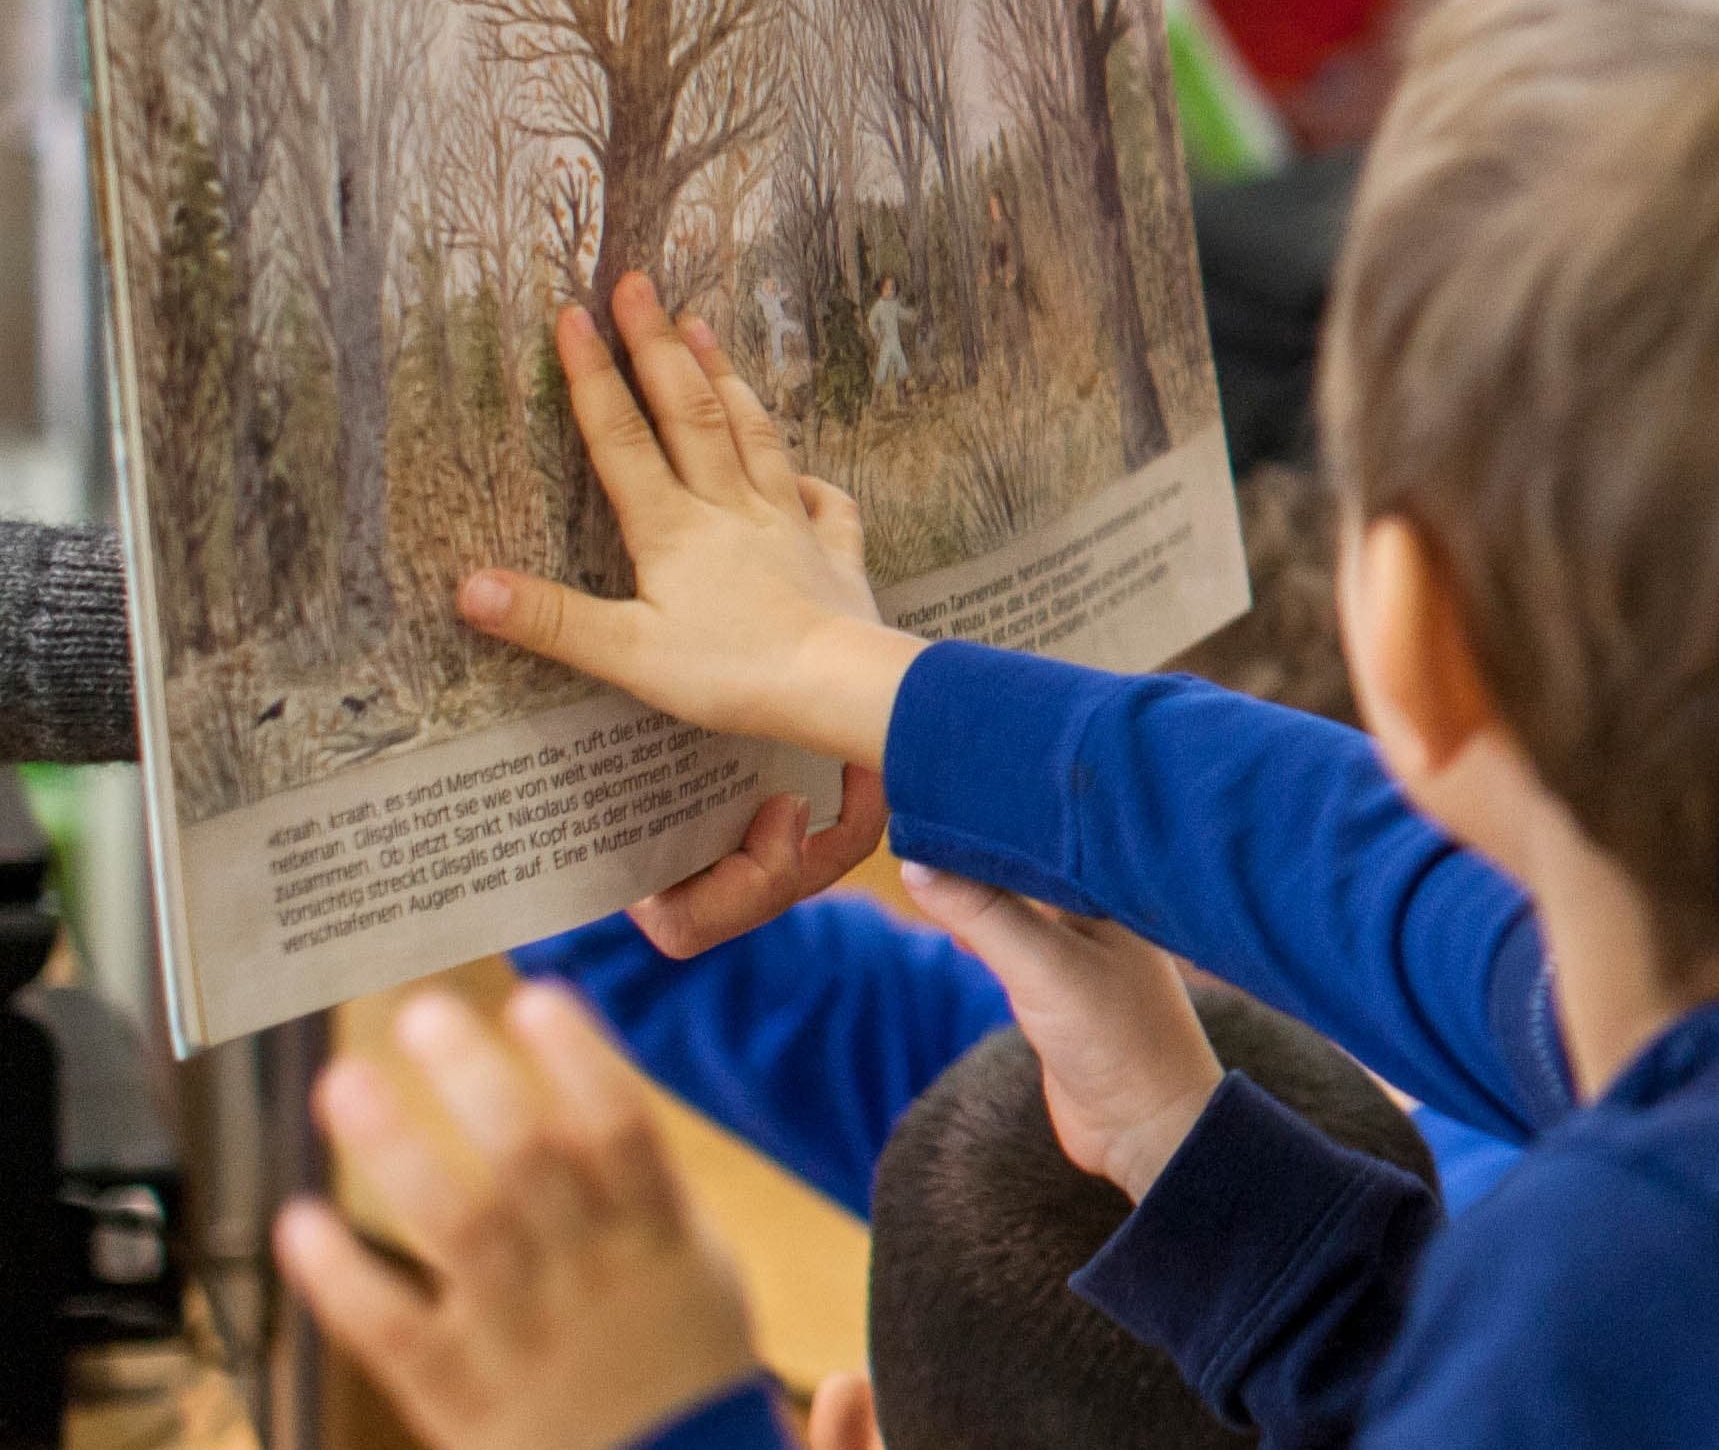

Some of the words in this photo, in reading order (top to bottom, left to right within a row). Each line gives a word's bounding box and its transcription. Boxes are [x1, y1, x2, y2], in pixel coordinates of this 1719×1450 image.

[367, 864, 429, 899] streckt
[492, 835, 526, 862] den
[529, 820, 568, 850] Kopf
[572, 816, 600, 838] aus
[603, 803, 628, 827] der
[679, 769, 719, 798] macht
[721, 757, 740, 781] die
[379, 845, 405, 870] Ob
[408, 832, 450, 864] jetzt
[454, 814, 502, 846] Sankt
[507, 793, 579, 829] Nikolaus
[583, 761, 672, 810] gekommen
[675, 751, 699, 776] ist?
[385, 794, 404, 813] es
[407, 781, 443, 807] sind
[447, 753, 535, 793] Menschen
[575, 730, 607, 755] ruft
[609, 725, 634, 746] die
[414, 804, 451, 830] hört
[455, 797, 479, 819] sie
[482, 788, 512, 810] wie
[515, 778, 548, 800] von
[551, 763, 587, 790] weit
[631, 739, 664, 765] aber
[667, 725, 704, 752] dann
[408, 882, 466, 915] Augen
[471, 868, 509, 895] weit
[553, 843, 589, 871] Eine
[593, 823, 643, 855] Mutter
[648, 799, 704, 838] sammelt
[706, 785, 728, 811] mit
